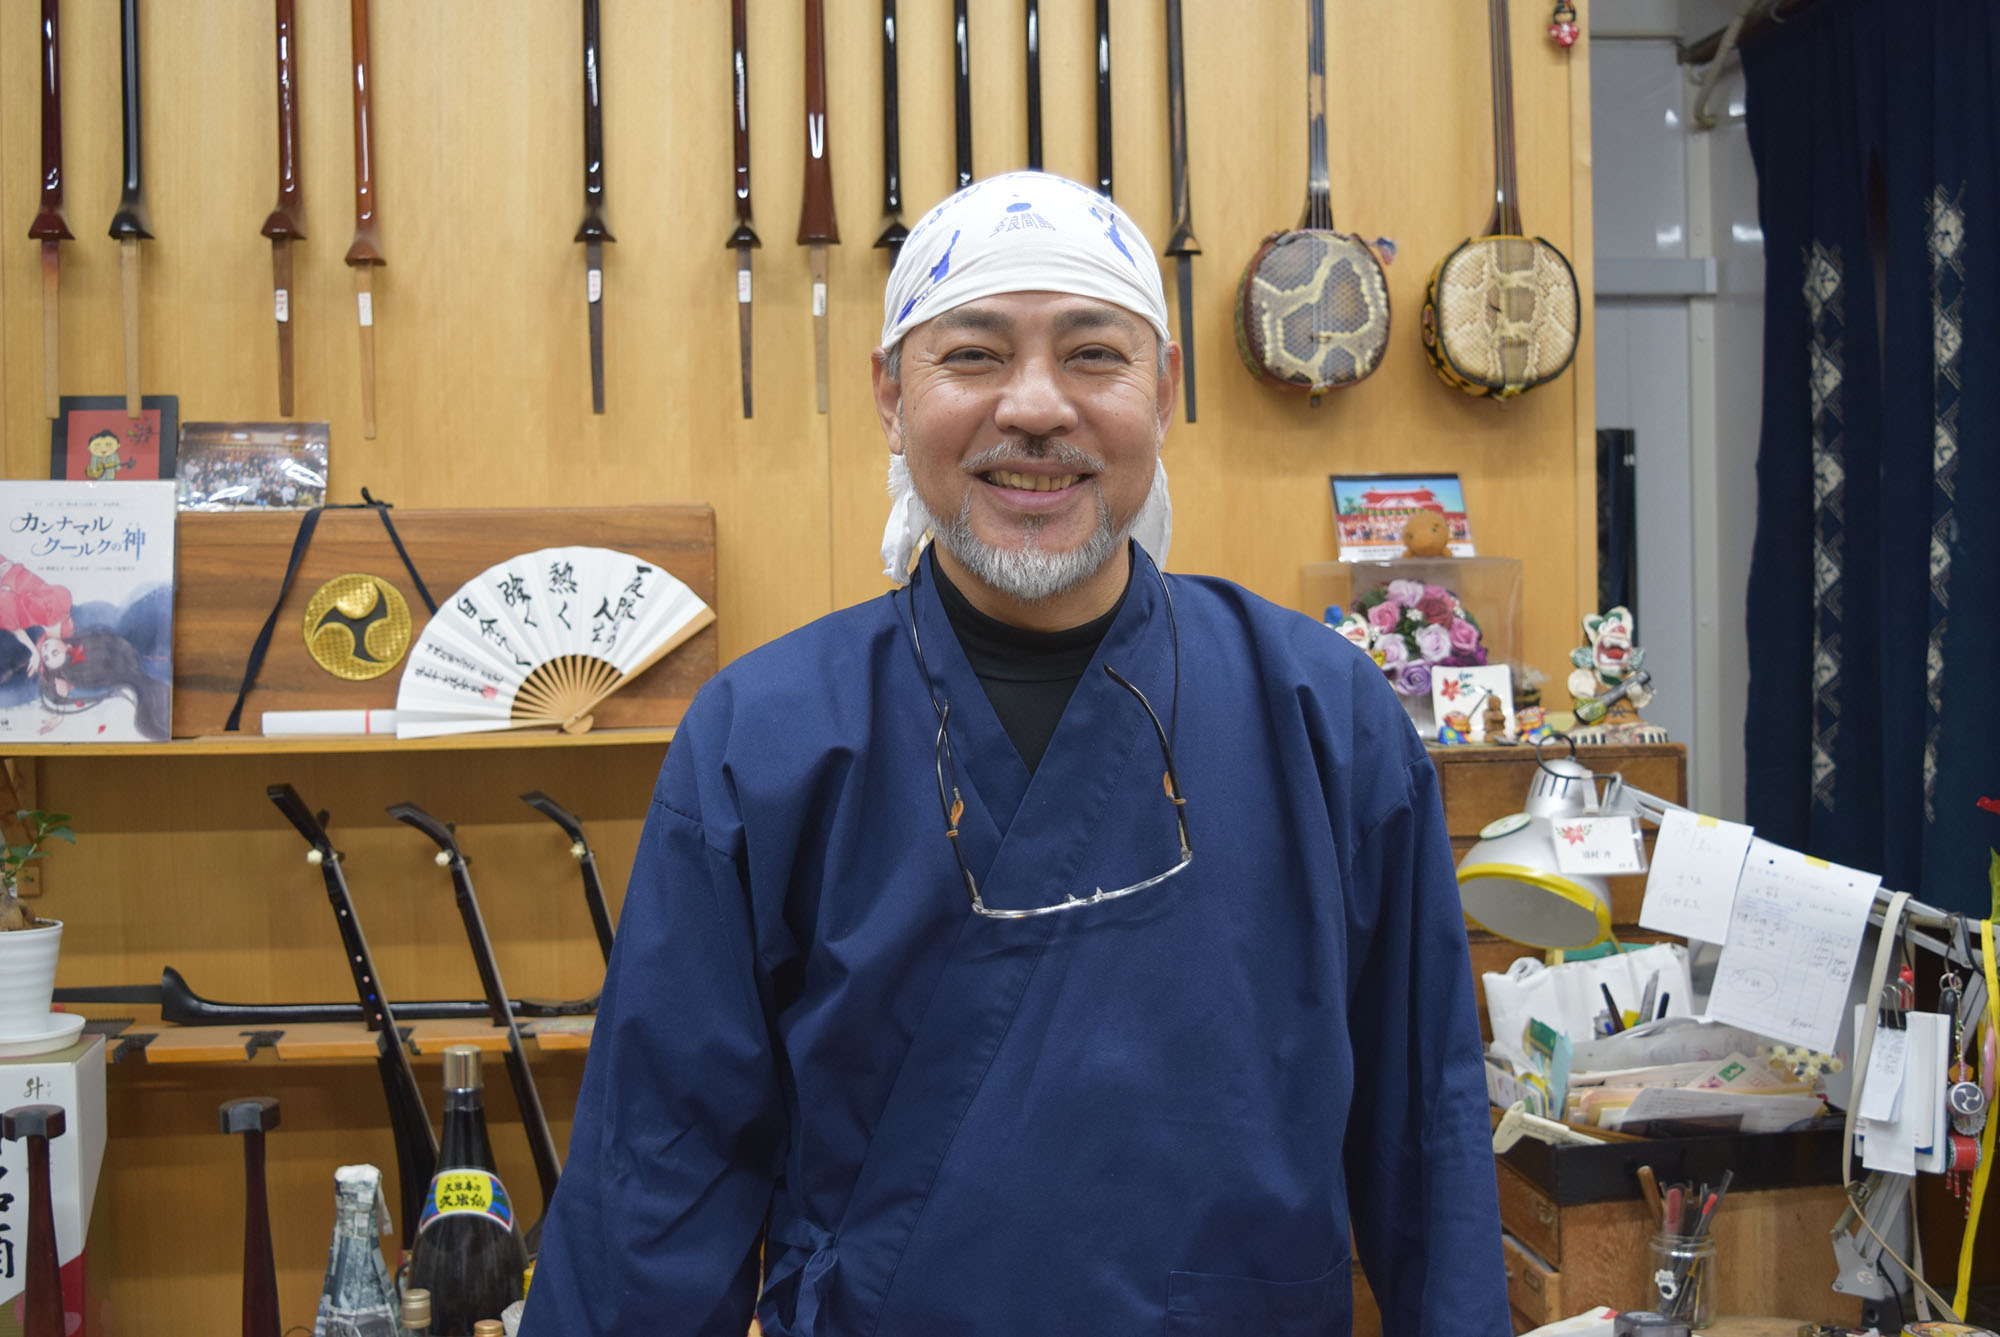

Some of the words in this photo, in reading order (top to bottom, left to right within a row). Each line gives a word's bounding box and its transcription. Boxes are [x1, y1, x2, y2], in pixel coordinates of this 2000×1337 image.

[9, 512, 113, 536] カンナマル
[31, 527, 146, 561] クールクの神
